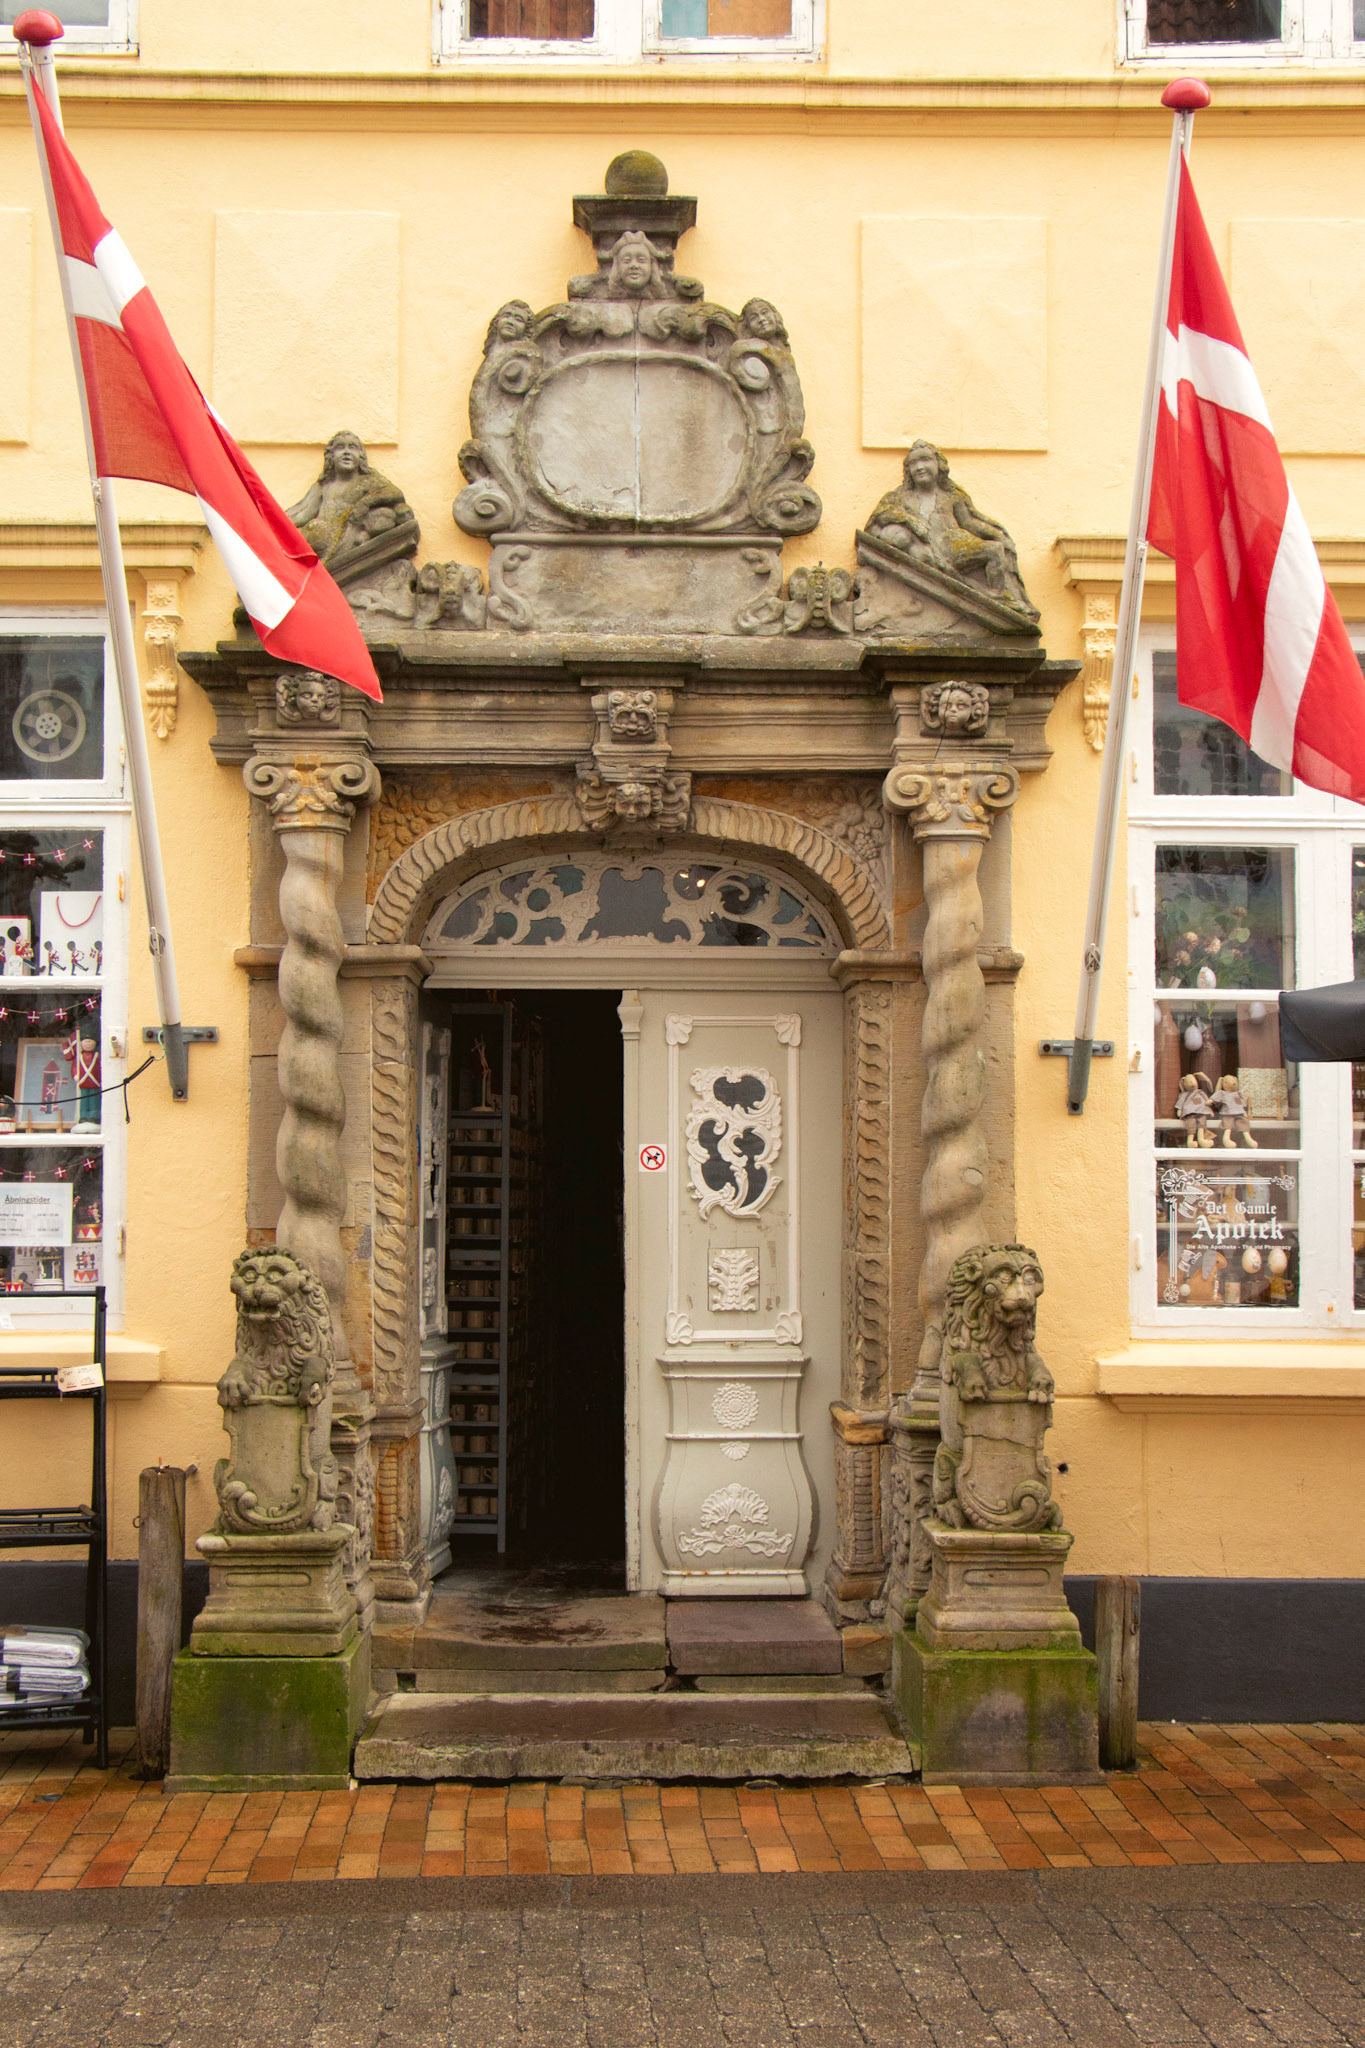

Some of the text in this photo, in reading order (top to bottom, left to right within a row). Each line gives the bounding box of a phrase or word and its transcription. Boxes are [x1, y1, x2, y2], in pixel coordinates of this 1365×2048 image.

[5, 1195, 51, 1204] Åbningstider
[1205, 1201, 1277, 1214] Det Gamle
[1192, 1216, 1284, 1244] Apotek
